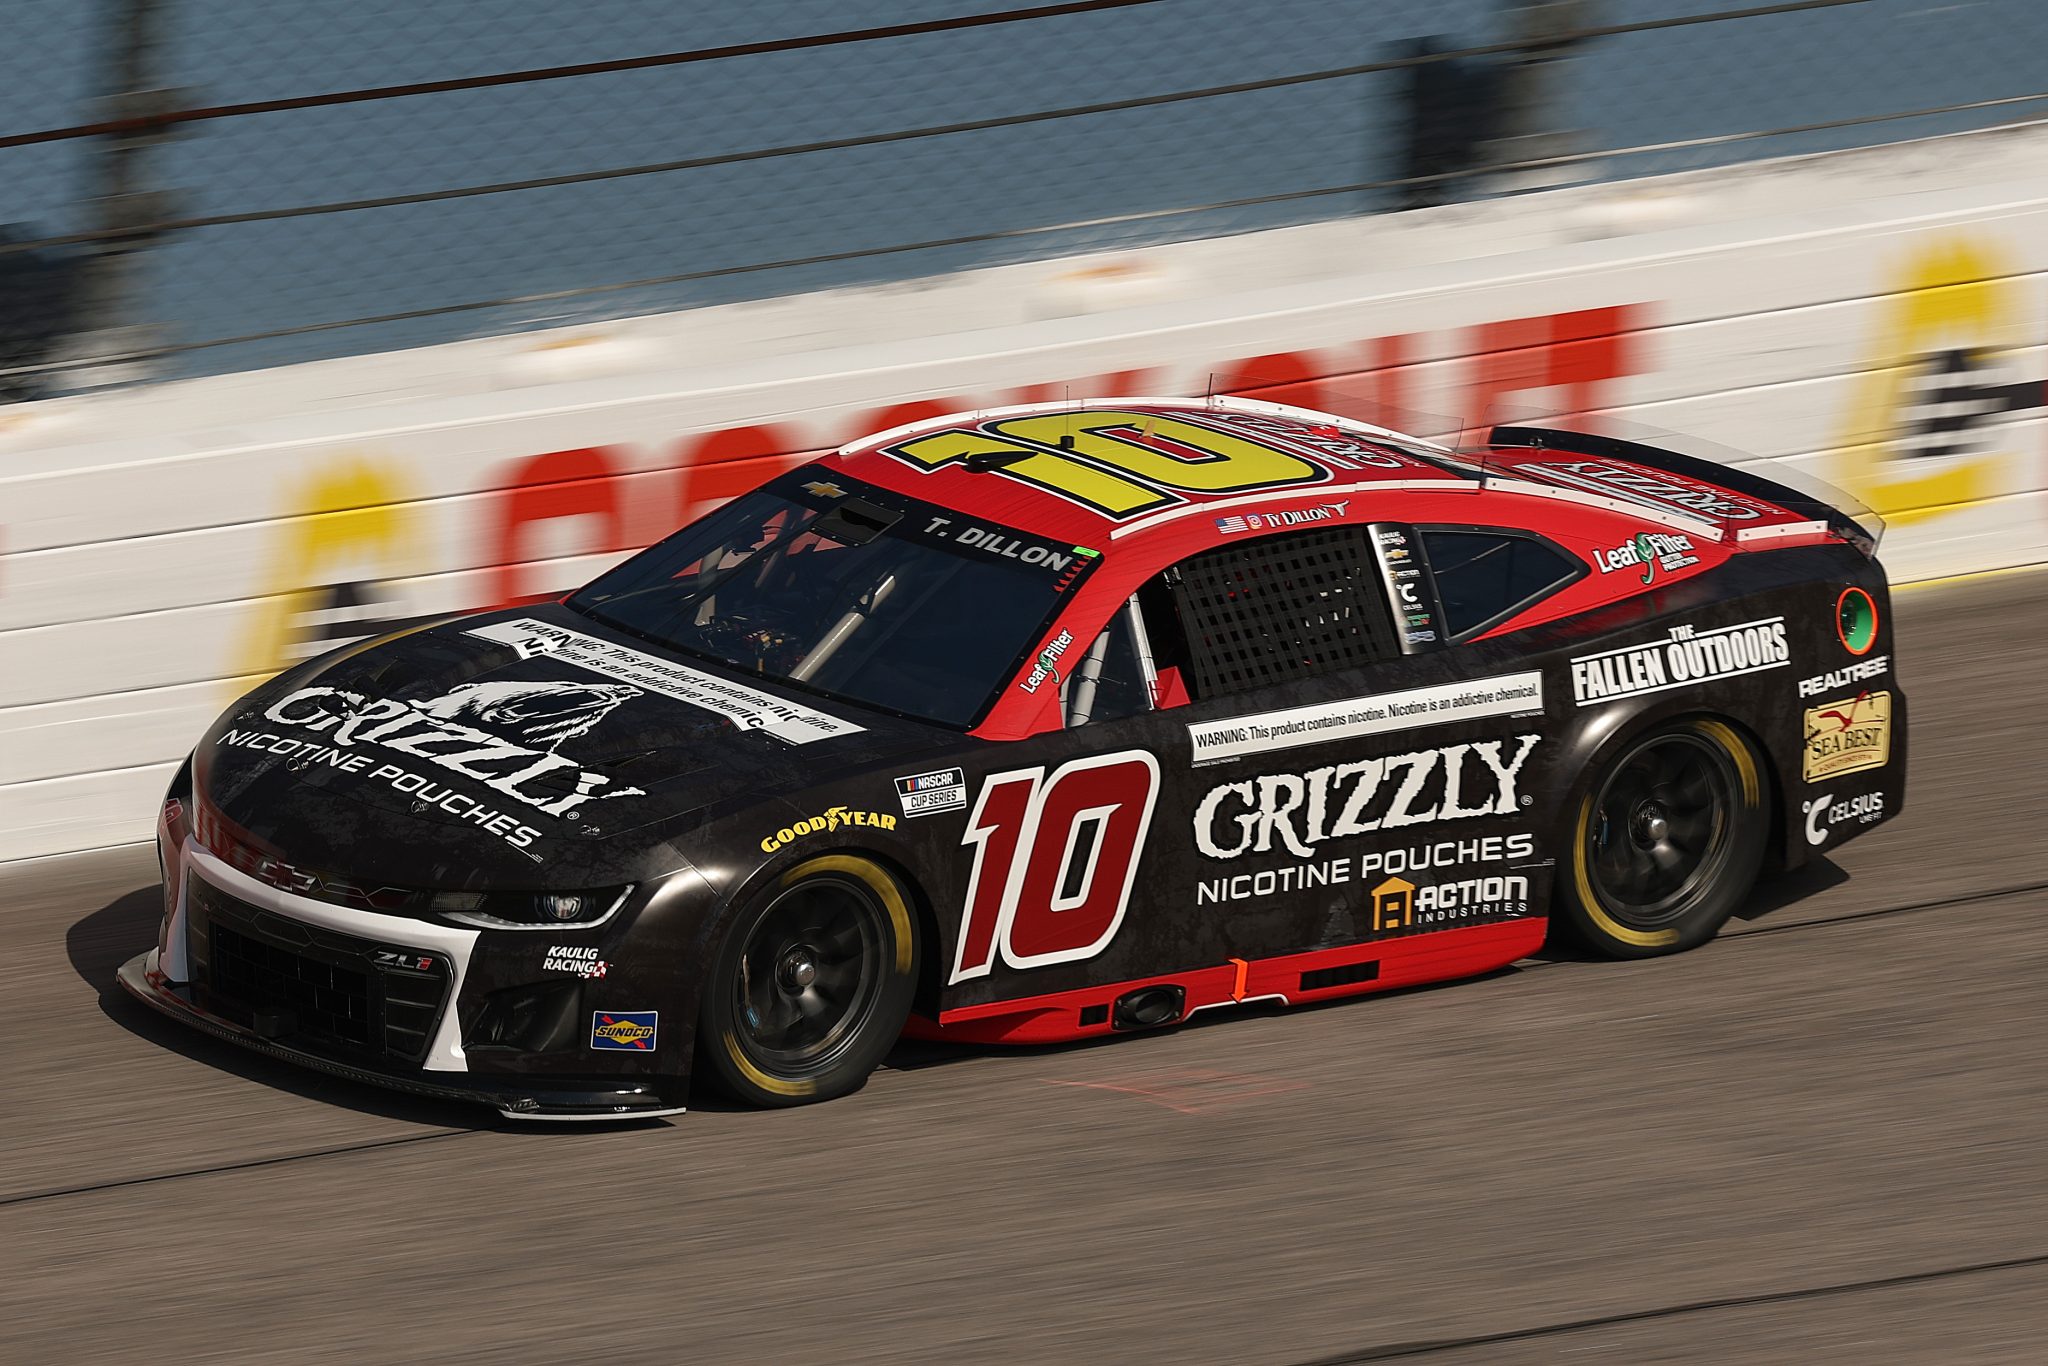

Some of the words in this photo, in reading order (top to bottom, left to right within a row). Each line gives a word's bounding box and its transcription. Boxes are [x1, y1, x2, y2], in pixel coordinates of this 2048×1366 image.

[877, 411, 1335, 522] 10
[1540, 461, 1762, 521] GRIZZLY
[923, 517, 951, 537] T.
[955, 527, 1073, 571] DILLON
[1668, 624, 1695, 642] THE
[584, 658, 606, 666] is
[601, 664, 629, 674] an
[624, 672, 703, 698] addictive
[1571, 648, 1667, 700] FALLEN
[1667, 622, 1790, 681] OUTDOORS
[1798, 656, 1888, 698] REALTREE
[601, 648, 641, 662] This
[629, 661, 706, 685] product
[699, 682, 774, 707] contains
[768, 705, 839, 733] nictine.
[1195, 728, 1249, 748] WARNING:
[1249, 725, 1269, 739] This
[1271, 720, 1306, 740] product
[1308, 713, 1346, 731] contains
[1348, 707, 1387, 725] nicotine.
[1388, 700, 1428, 718] Nicotine
[1429, 698, 1437, 711] is
[1439, 699, 1451, 710] an
[1452, 691, 1494, 708] addictive
[1495, 683, 1539, 702] chemical.
[264, 686, 646, 818] GRIZZLY
[1812, 735, 1841, 760] SEA
[1844, 728, 1881, 749] BEST
[217, 729, 374, 773] NICOTINE
[369, 764, 543, 848] POUCHES
[910, 794, 927, 808] CUP
[929, 790, 957, 805] SERIES
[919, 773, 953, 790] NASCAR
[1193, 734, 1542, 859] GRIZZLY
[1828, 792, 1884, 824] CELSIUS
[948, 749, 1161, 986] 10
[1197, 858, 1350, 905] NICOTINE
[1362, 833, 1533, 878] POUCHES
[1414, 876, 1528, 912] ACTION
[1418, 902, 1528, 924] INDUSTRIES
[374, 951, 432, 970] ZL1
[543, 958, 595, 973] RACING
[547, 946, 598, 960] KAULIG
[596, 1026, 652, 1038] SUNOCO
